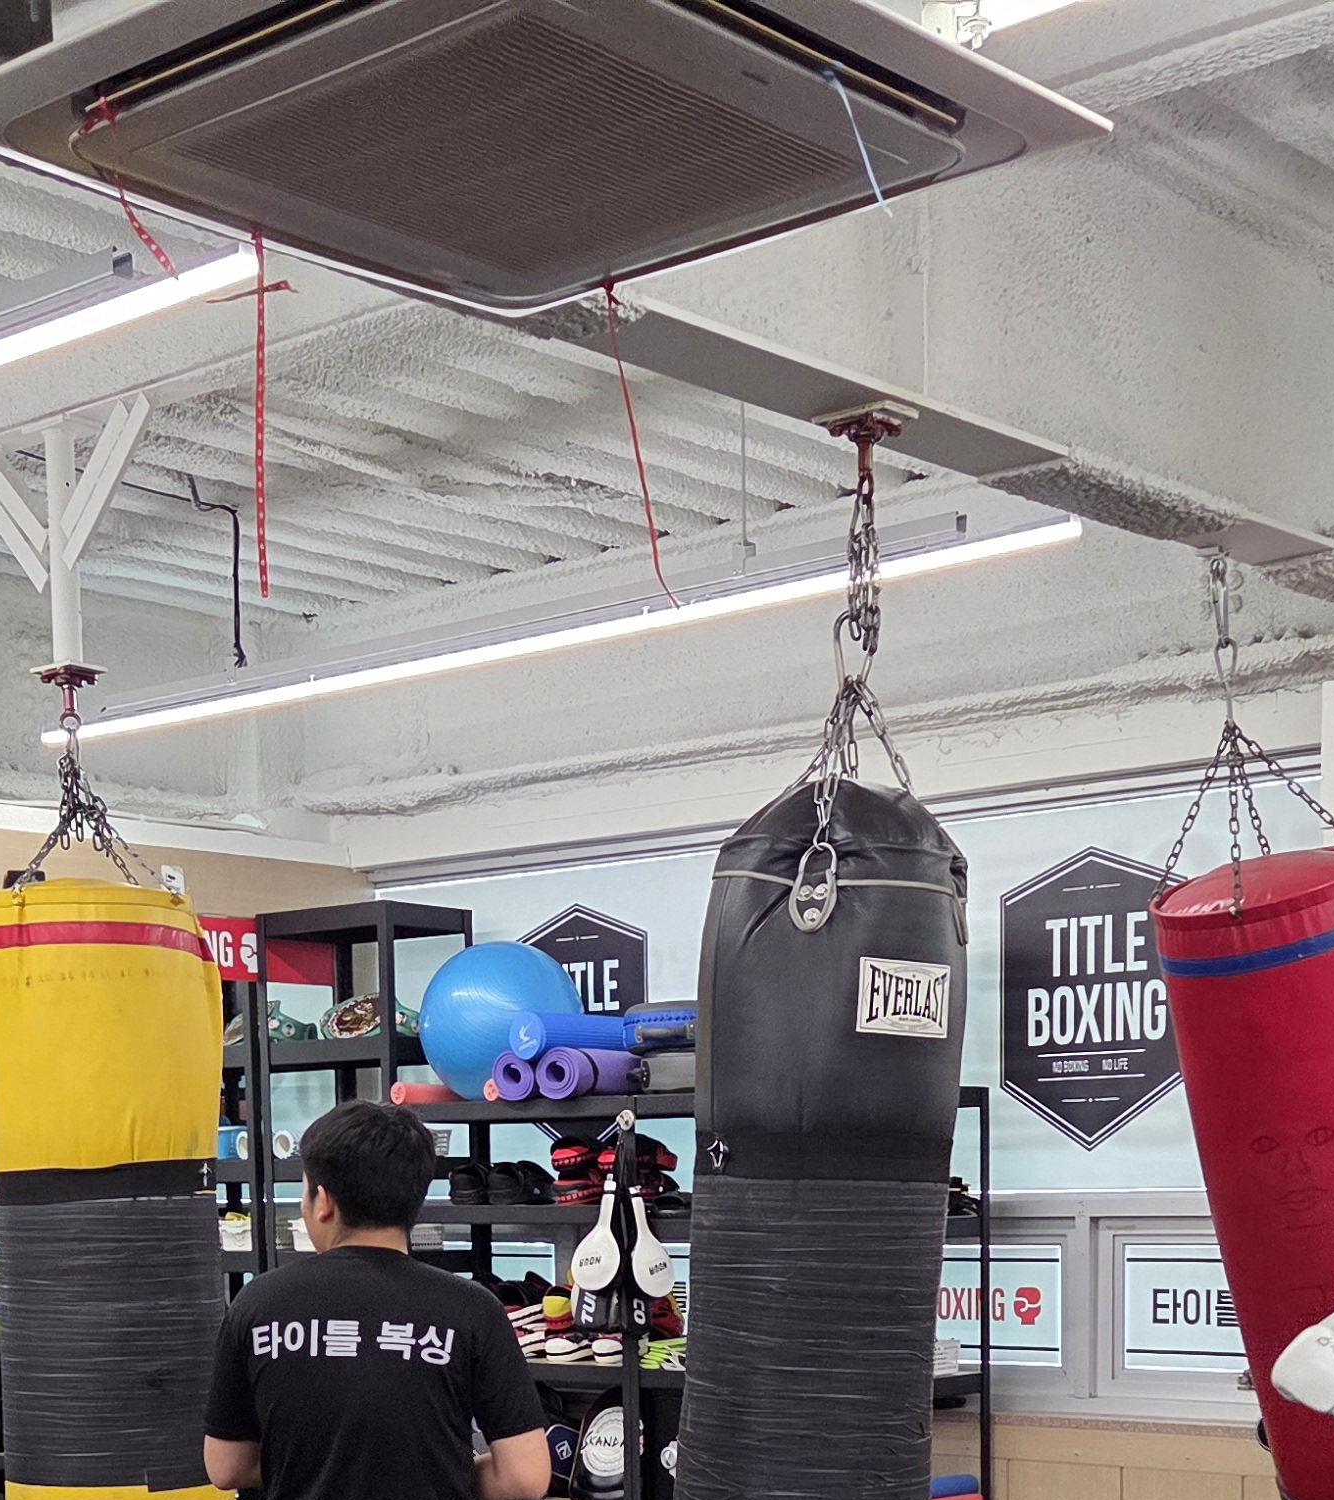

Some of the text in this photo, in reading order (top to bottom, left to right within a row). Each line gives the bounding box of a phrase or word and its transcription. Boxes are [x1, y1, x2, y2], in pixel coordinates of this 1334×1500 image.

[1045, 911, 1149, 977] TITLE
[561, 958, 620, 1012] TLE
[866, 963, 947, 1028] EVERLAST
[1027, 979, 1167, 1047] BOXING
[1114, 1057, 1129, 1071] LIFE
[936, 1286, 1005, 1321] OXIG
[252, 1318, 455, 1366] 타이틀 복싱
